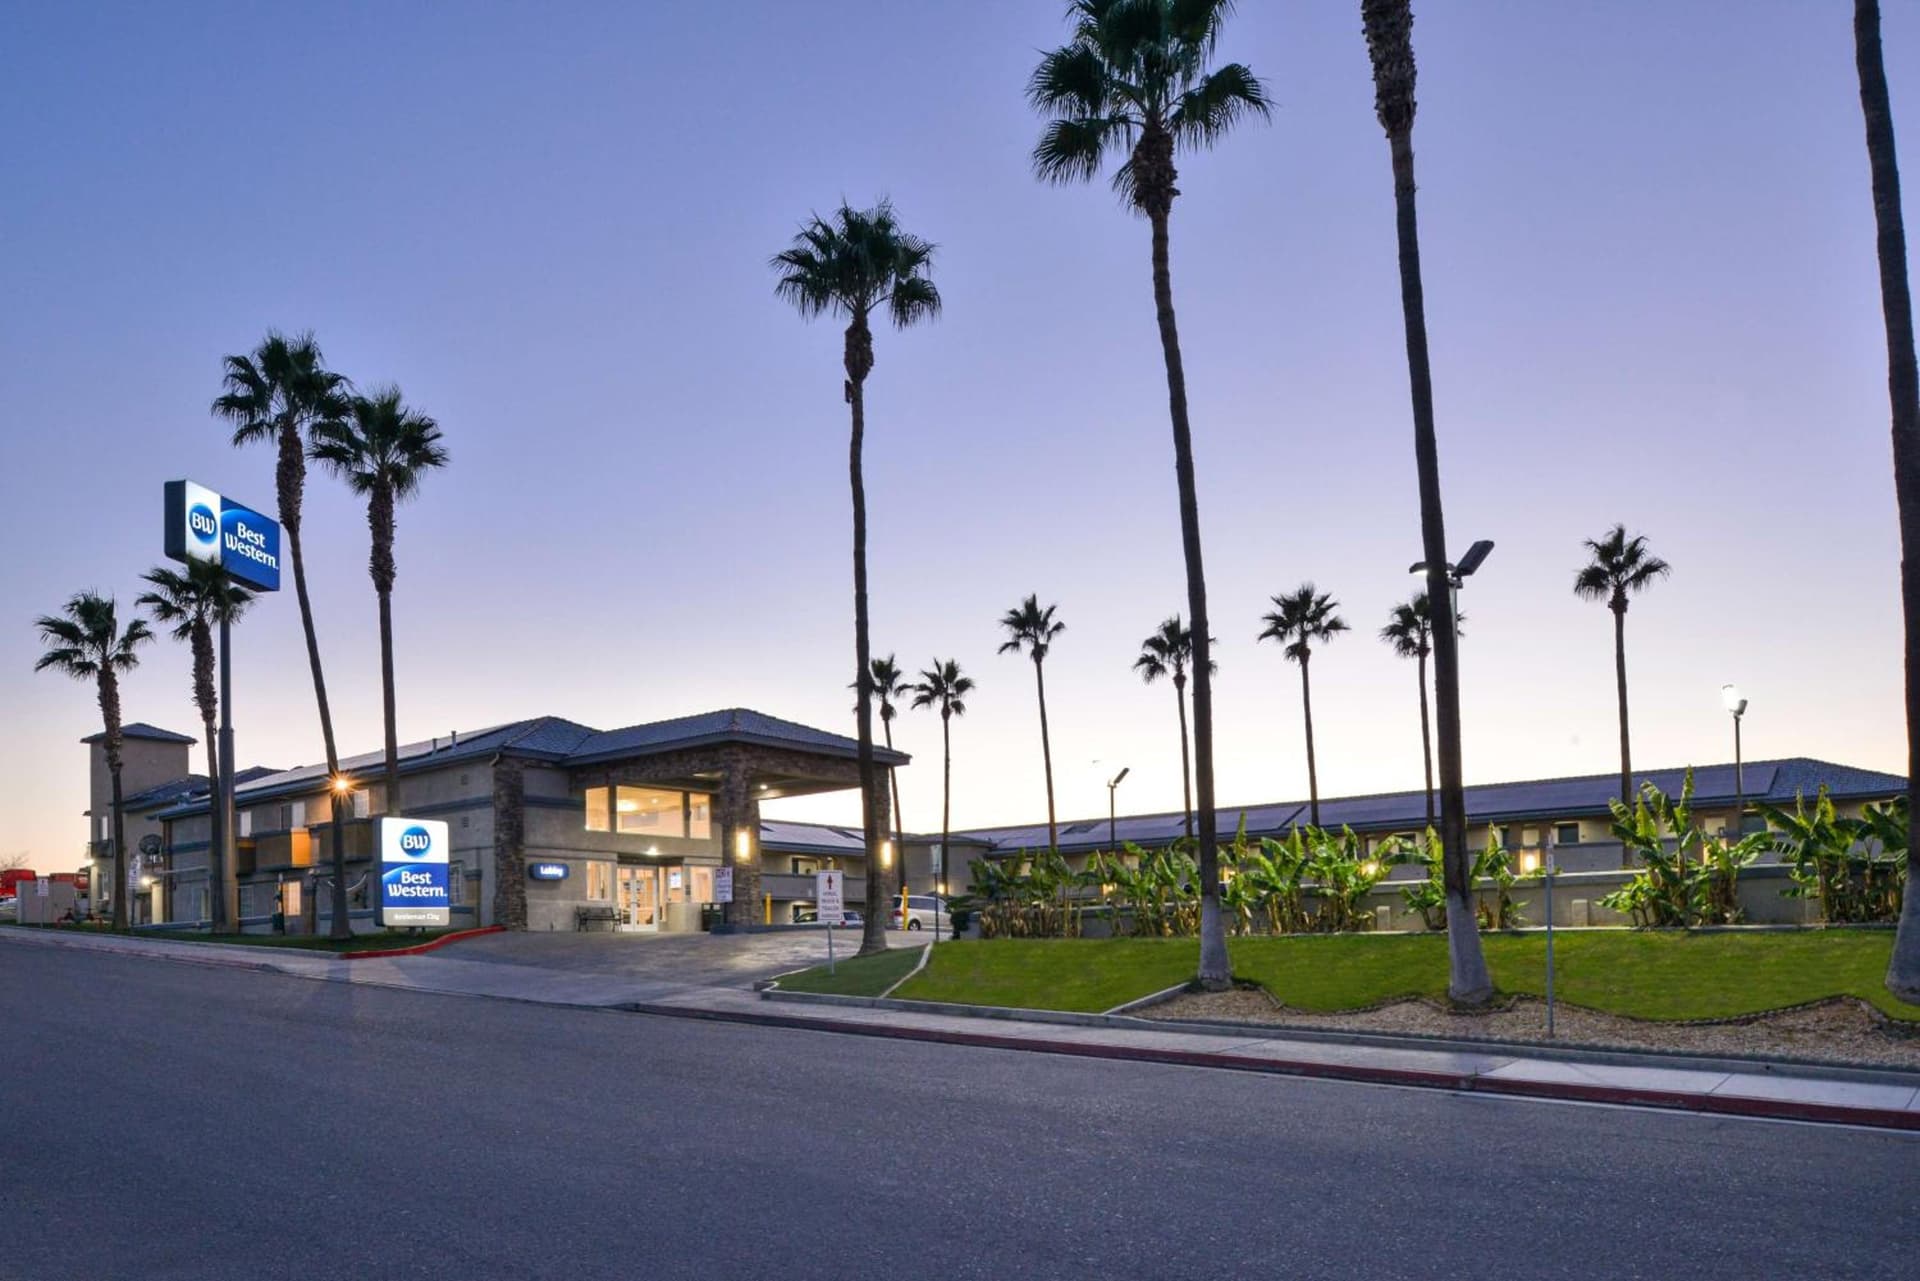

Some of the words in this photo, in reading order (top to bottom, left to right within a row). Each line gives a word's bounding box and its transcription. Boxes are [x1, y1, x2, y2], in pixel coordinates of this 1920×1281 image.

[192, 512, 215, 535] BW
[237, 521, 266, 549] Best
[403, 834, 429, 850] BW
[401, 870, 433, 885] Best
